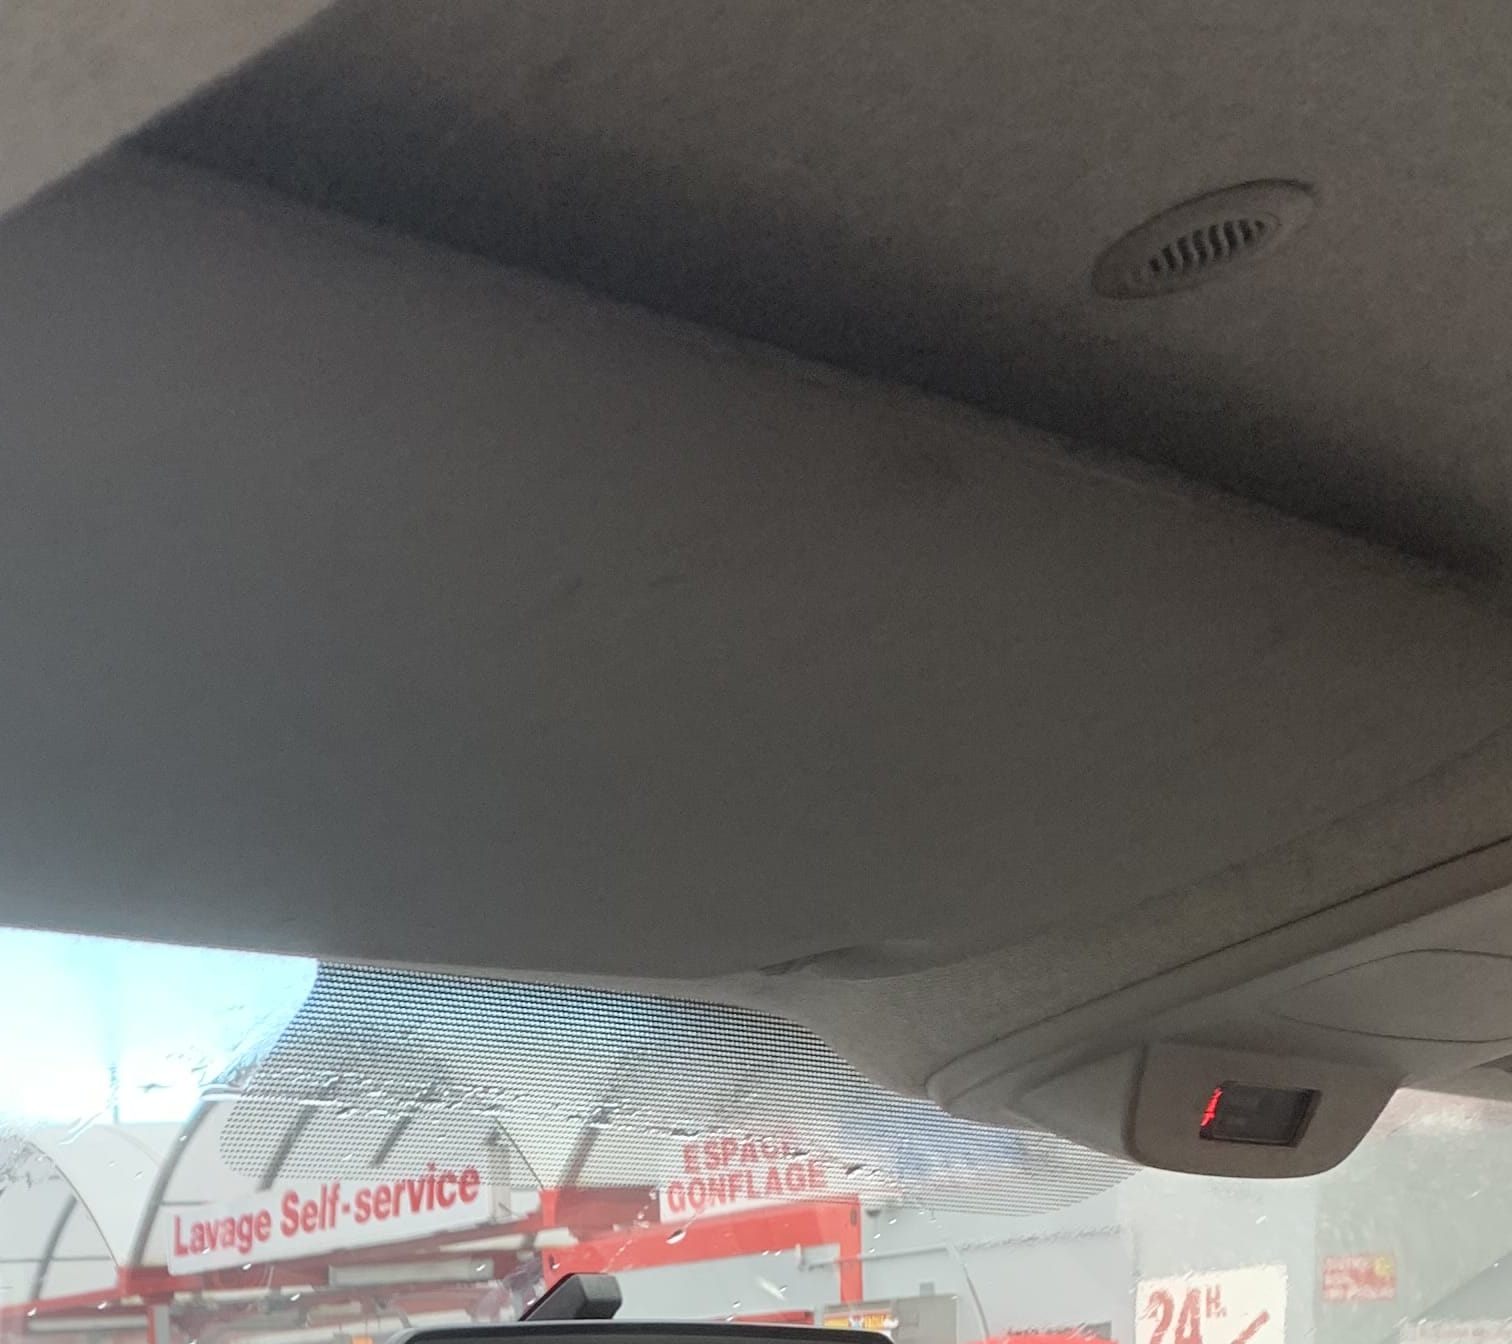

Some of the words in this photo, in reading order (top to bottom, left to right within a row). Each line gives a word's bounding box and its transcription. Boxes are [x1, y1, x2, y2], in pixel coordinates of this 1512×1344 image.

[174, 1210, 272, 1257] Lavage
[280, 1163, 481, 1237] Self-service
[666, 1160, 826, 1213] GONFLAGE
